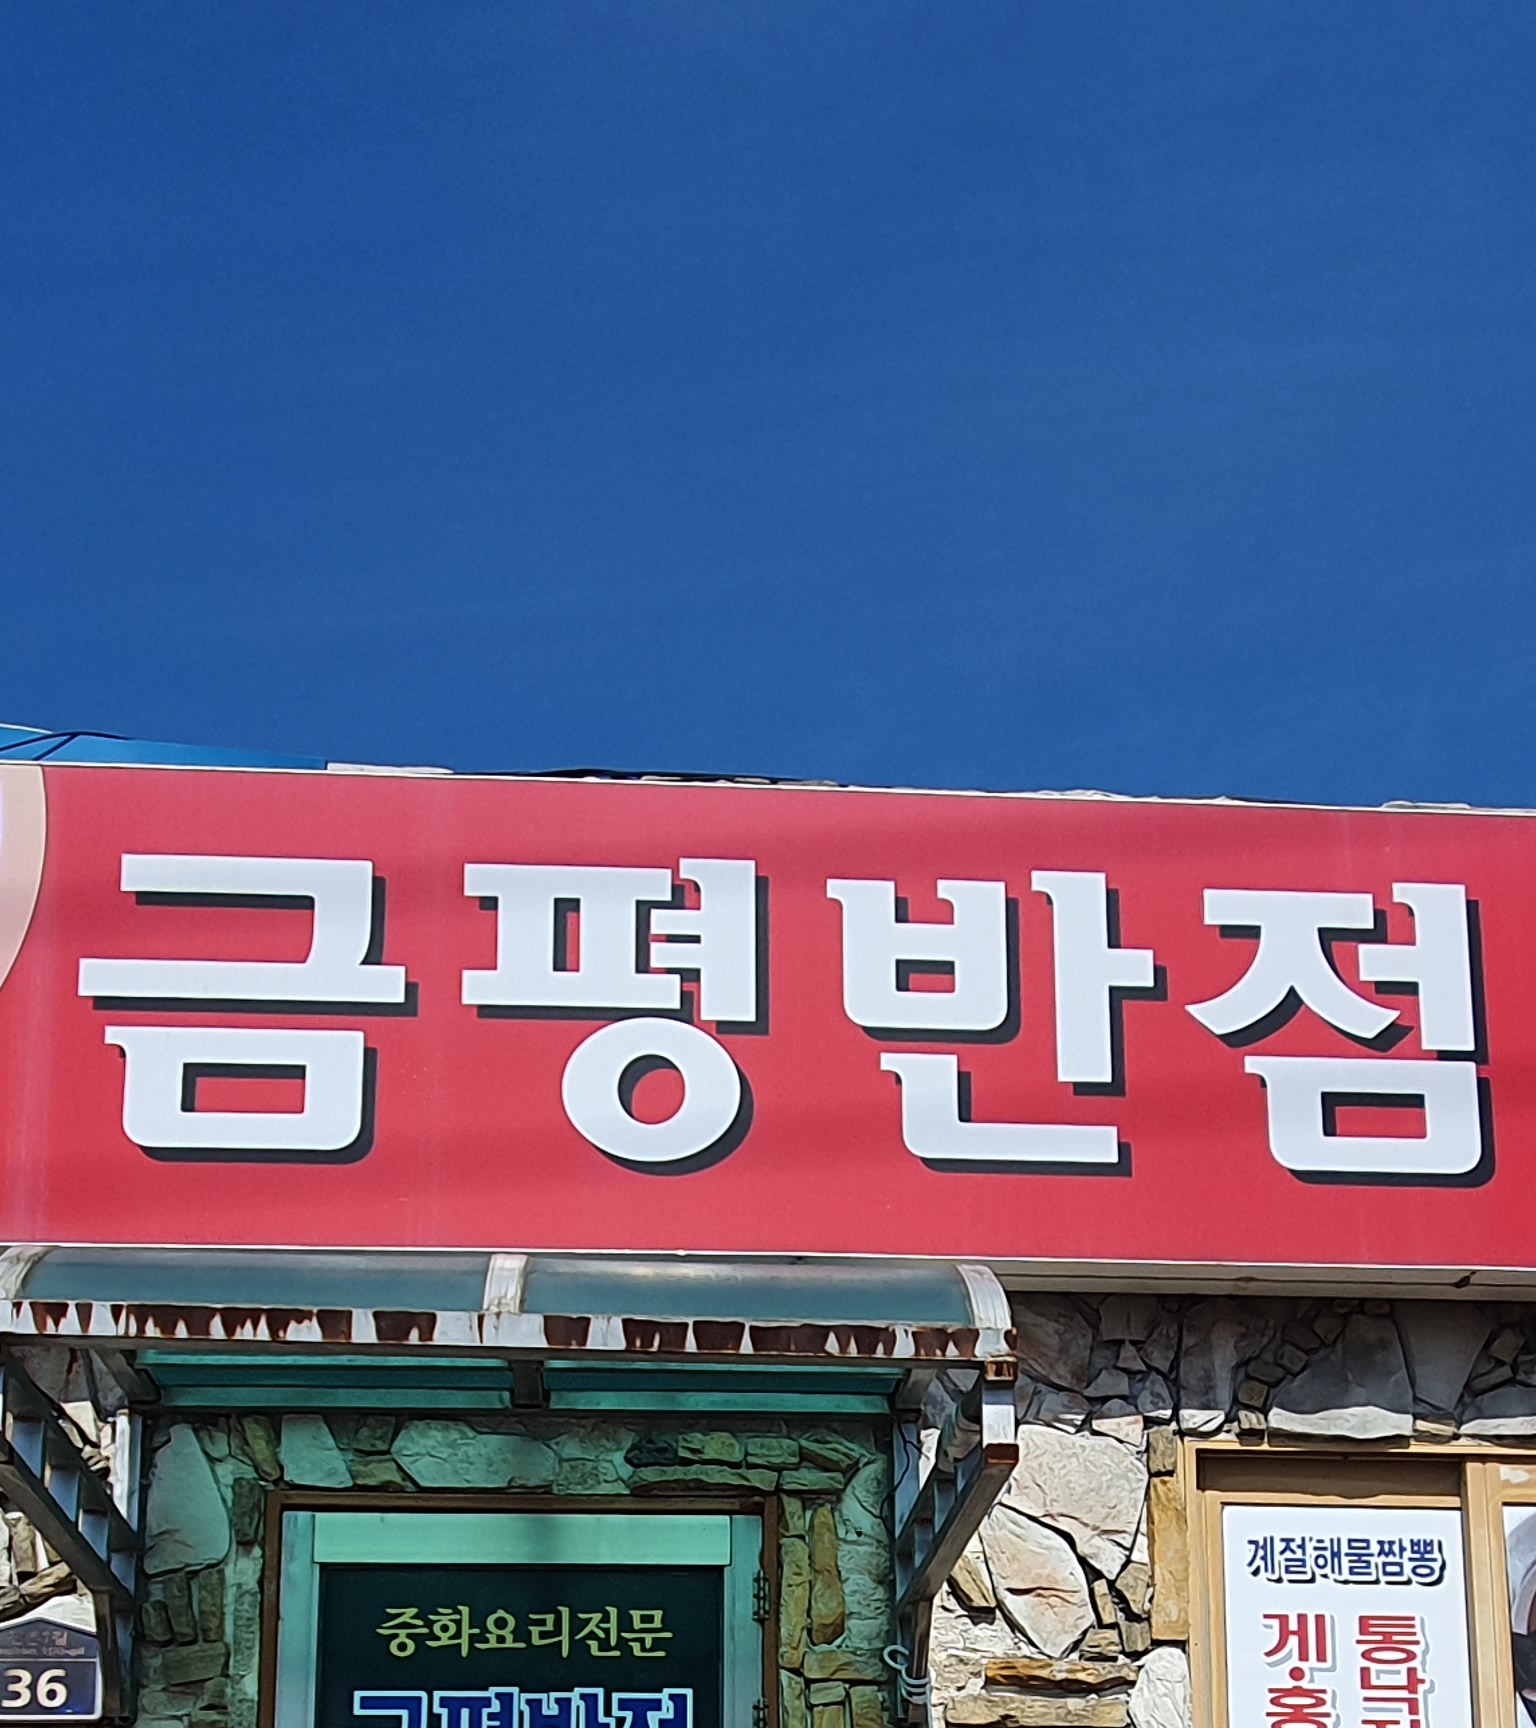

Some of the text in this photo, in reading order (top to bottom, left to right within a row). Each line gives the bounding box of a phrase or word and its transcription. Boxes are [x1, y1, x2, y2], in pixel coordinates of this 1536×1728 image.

[76, 852, 1486, 1175] 금평반점
[1245, 1535, 1443, 1581] 계절해물짬뽕
[375, 1604, 674, 1659] 중화요리전문
[1, 1667, 68, 1709] 36
